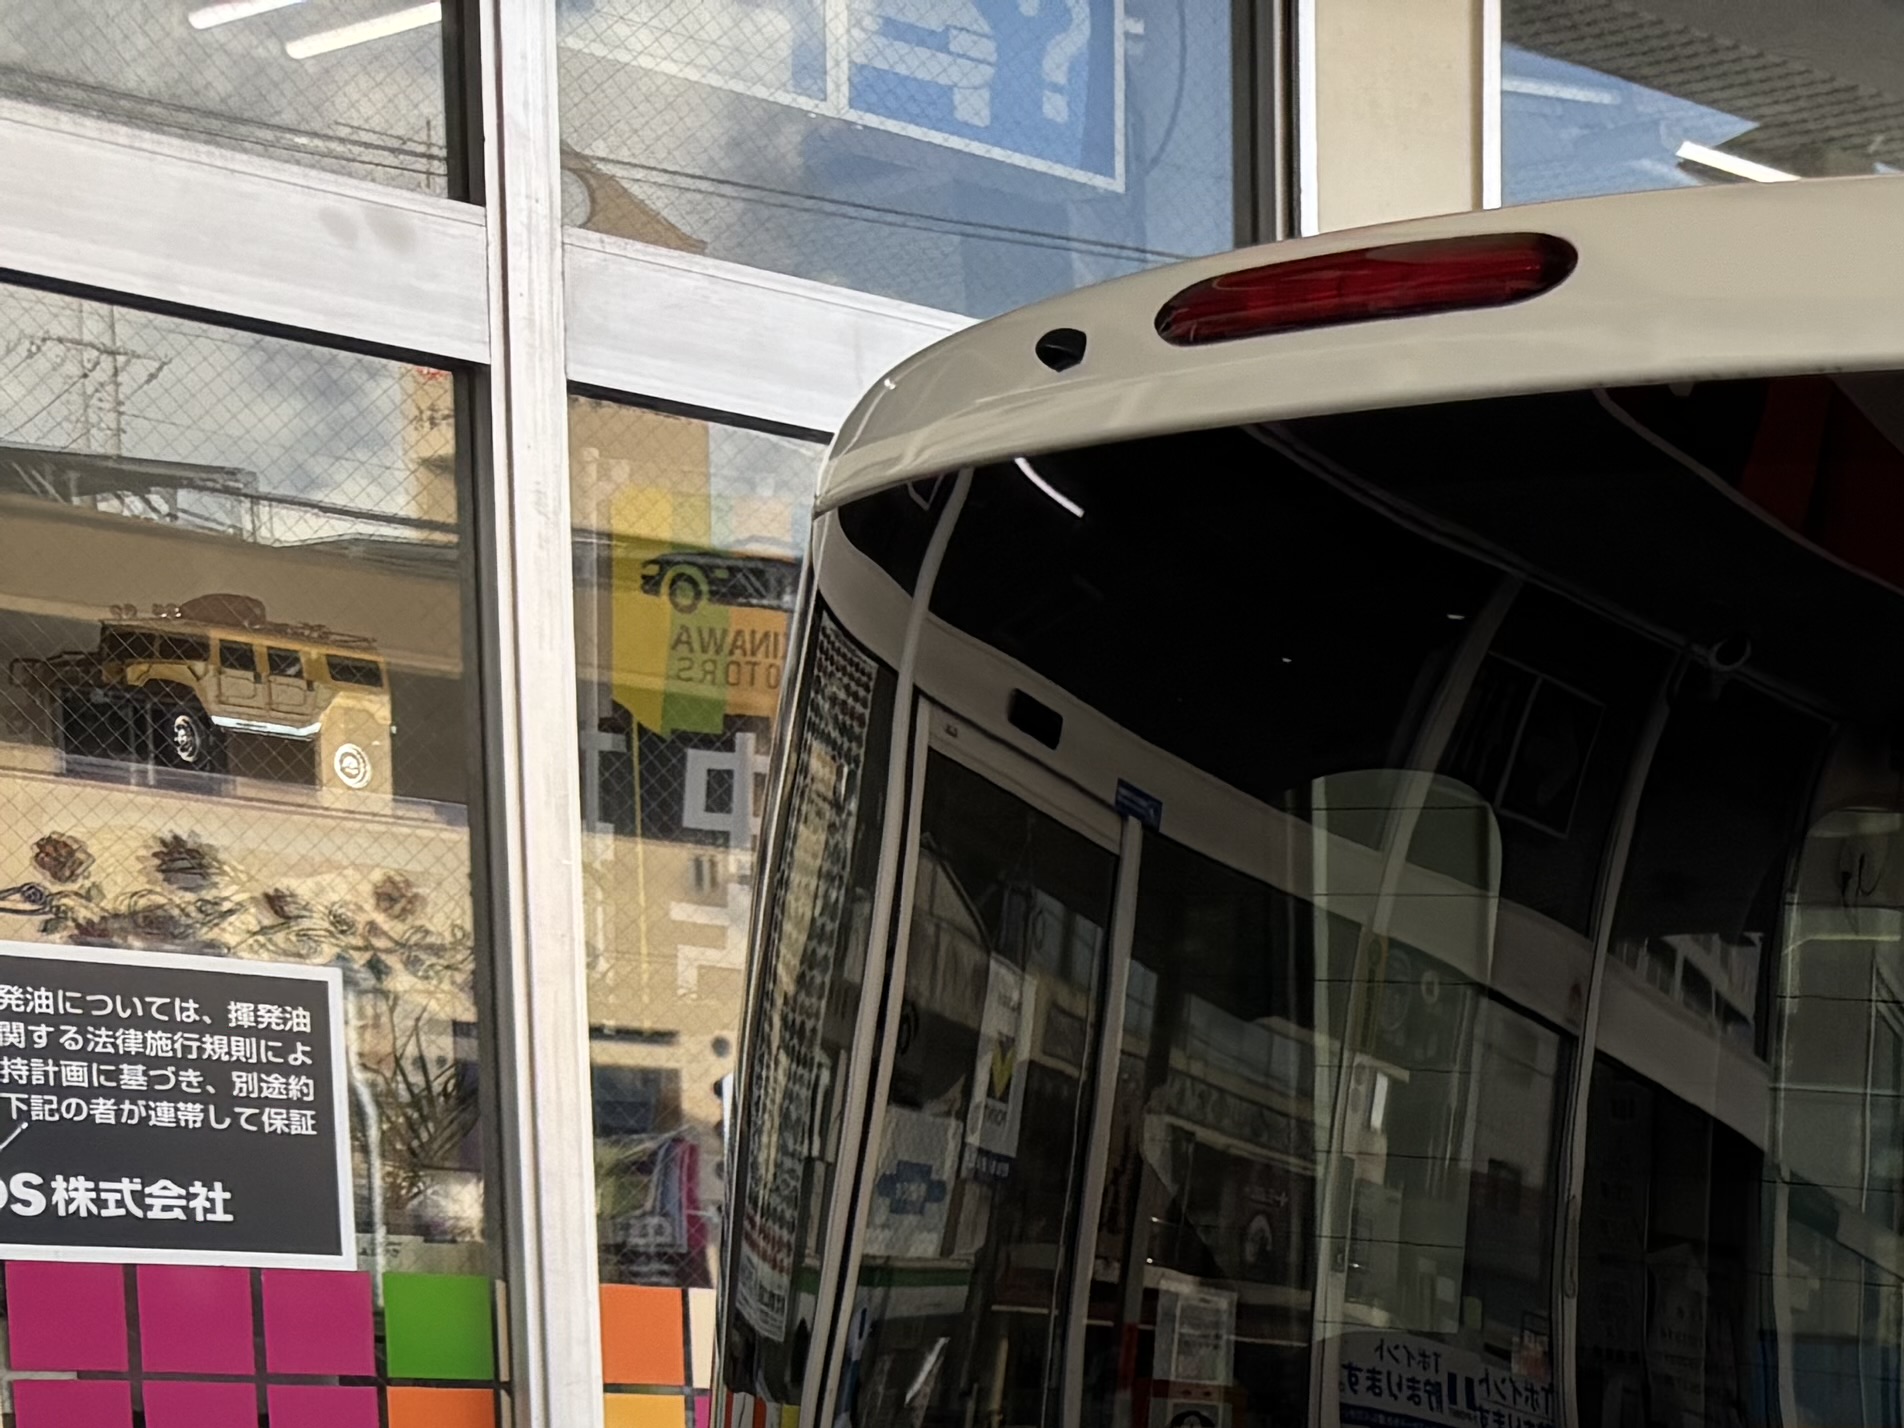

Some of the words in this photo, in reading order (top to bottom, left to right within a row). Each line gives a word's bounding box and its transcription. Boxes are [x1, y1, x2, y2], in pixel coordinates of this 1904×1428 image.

[0, 984, 312, 1034] 発油については、揮発油
[0, 1022, 313, 1067] 関する法律施行規則によ
[0, 1057, 316, 1102] 持計画に基づき、別途約
[0, 1092, 318, 1137] 下記の者が連帯して保証
